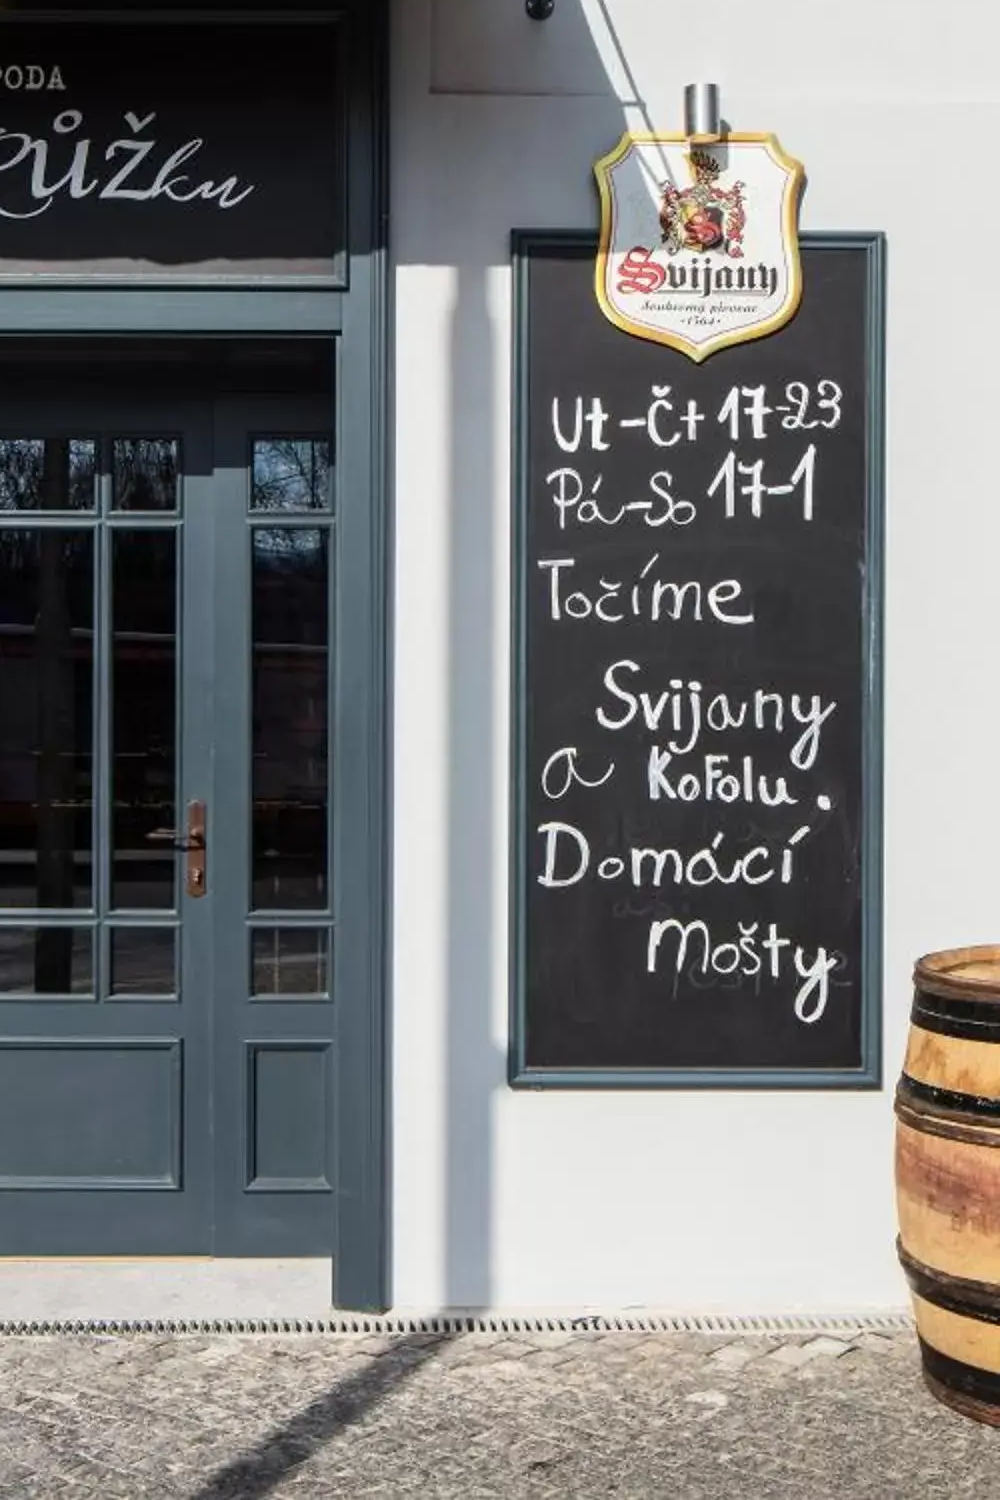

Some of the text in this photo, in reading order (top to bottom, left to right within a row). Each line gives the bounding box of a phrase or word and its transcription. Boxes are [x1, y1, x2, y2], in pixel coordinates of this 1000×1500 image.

[616, 246, 778, 296] Svijany
[537, 553, 755, 624] Točíme
[596, 659, 837, 771] Svijany
[537, 821, 811, 888] Domácí
[647, 917, 838, 1024] Mošty
